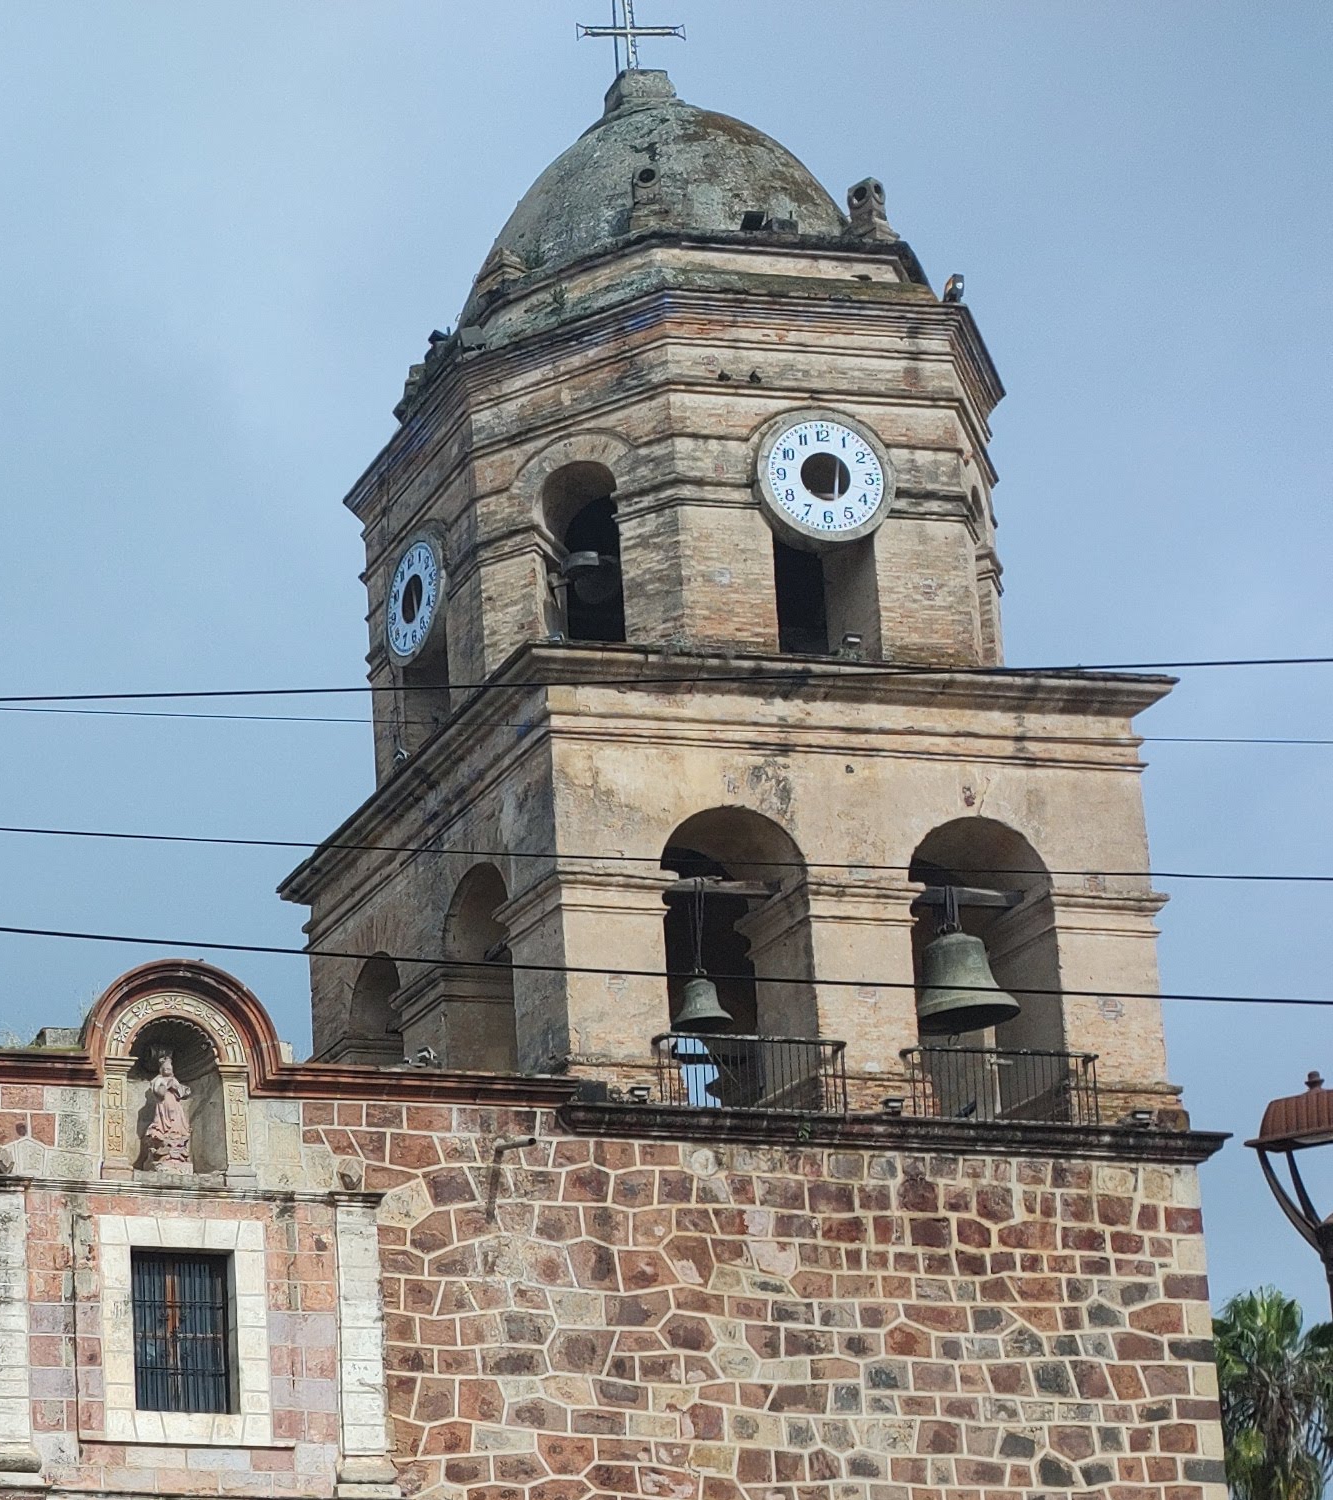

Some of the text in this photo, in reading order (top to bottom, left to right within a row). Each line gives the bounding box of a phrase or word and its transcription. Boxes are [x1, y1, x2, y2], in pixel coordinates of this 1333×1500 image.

[799, 434, 808, 446] 11
[816, 430, 830, 442] 12
[842, 436, 846, 448] 1
[783, 448, 794, 460] 10
[856, 451, 865, 464] 2
[776, 467, 786, 481] 9
[865, 473, 874, 485] 3
[785, 489, 794, 501] 8
[858, 493, 867, 505] 4
[804, 504, 812, 516] 7
[844, 507, 853, 519] 5
[823, 511, 833, 523] 6
